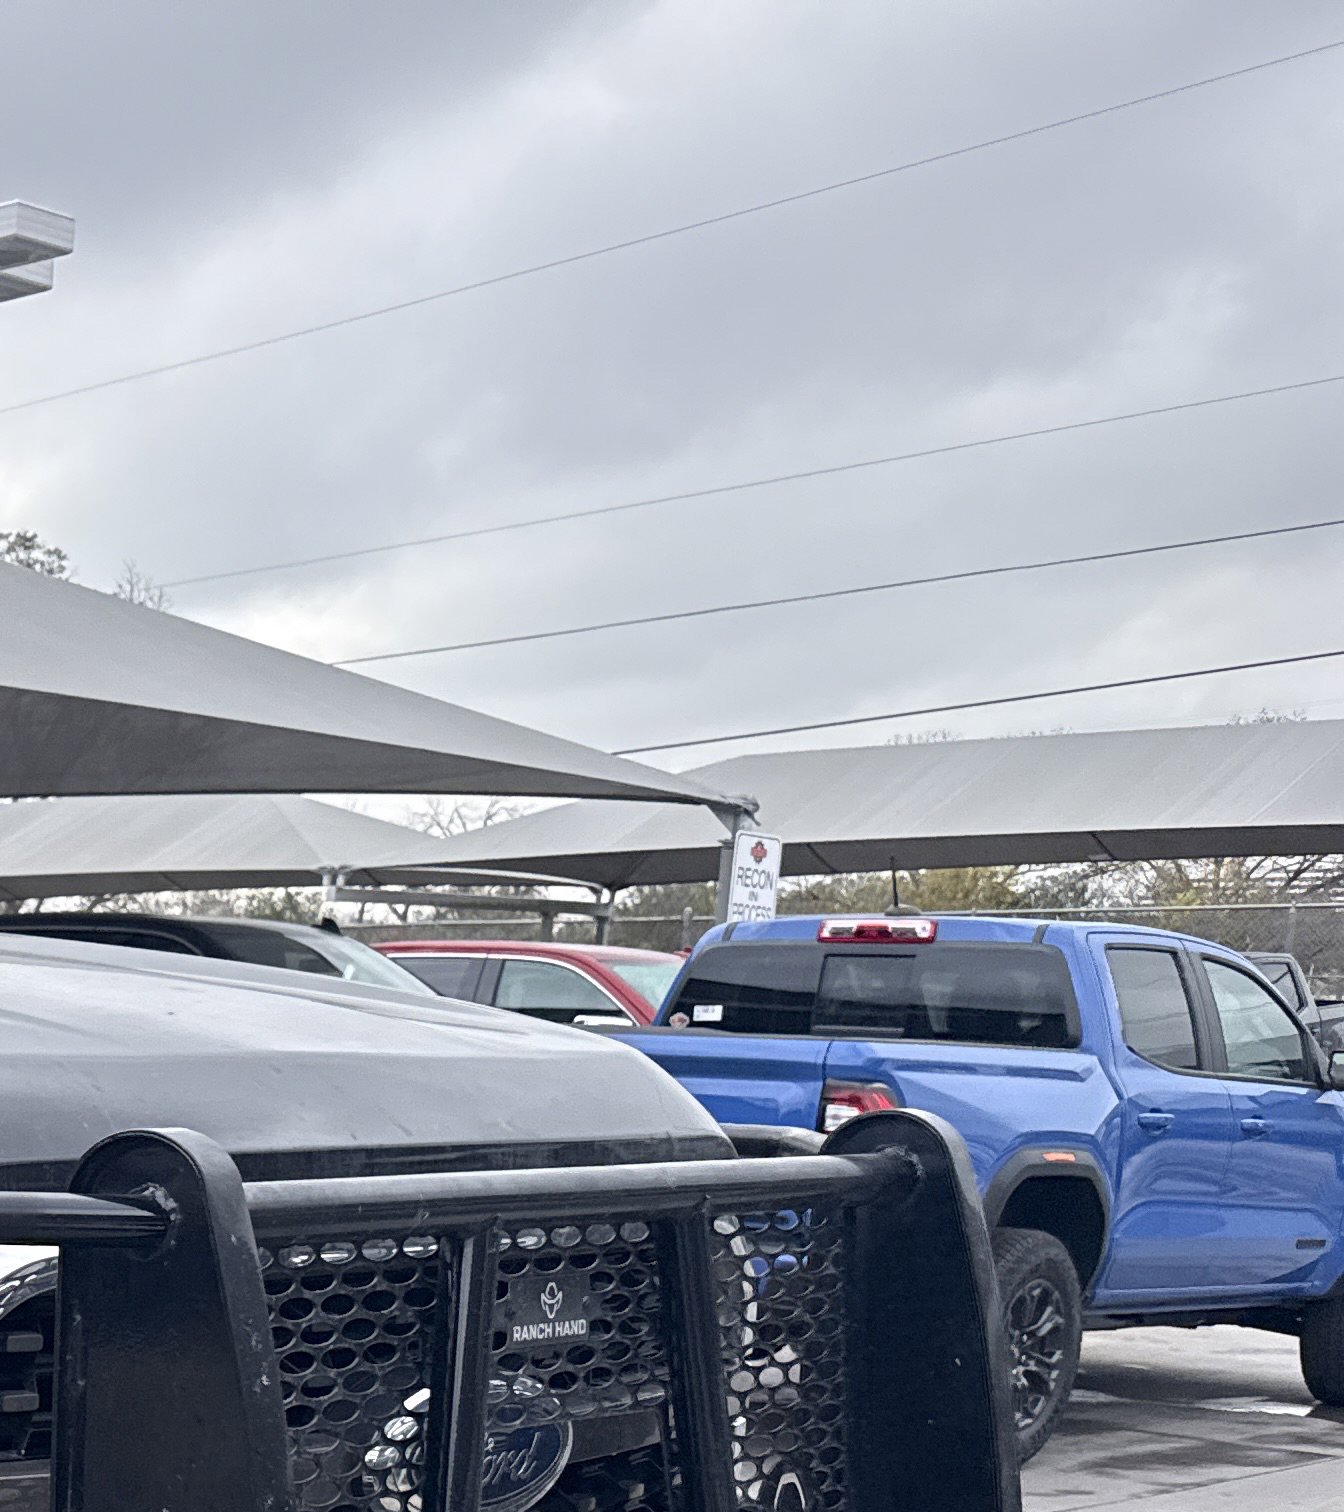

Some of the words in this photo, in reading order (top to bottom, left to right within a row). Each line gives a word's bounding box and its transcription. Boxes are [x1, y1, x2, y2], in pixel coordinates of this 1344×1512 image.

[736, 866, 774, 890] RECON
[748, 890, 758, 902] IN
[732, 902, 772, 921] PROCESS
[512, 1322, 553, 1342] RANCH
[554, 1318, 587, 1338] HAND
